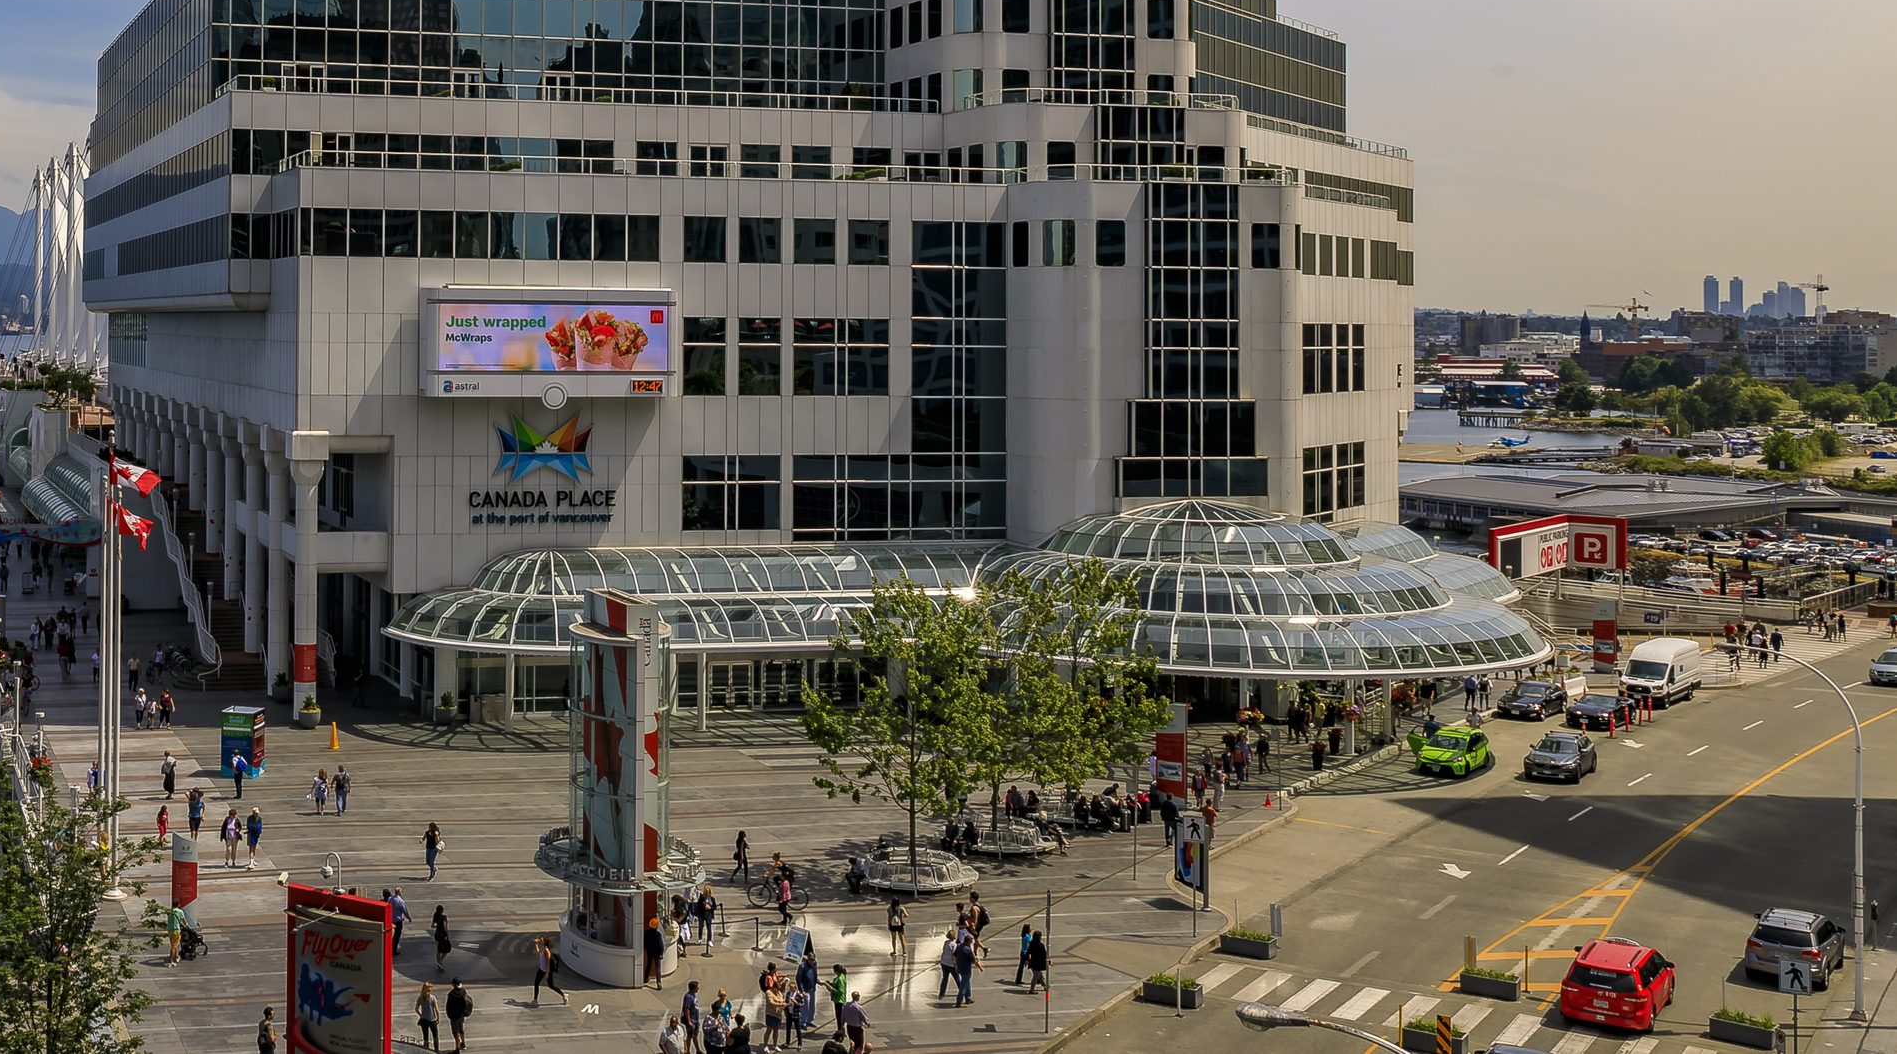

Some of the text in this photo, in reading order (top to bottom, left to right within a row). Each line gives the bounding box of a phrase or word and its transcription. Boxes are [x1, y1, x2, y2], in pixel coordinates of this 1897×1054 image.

[445, 315, 547, 331] Just wrapped
[445, 333, 493, 344] McWraps
[454, 382, 480, 391] astral
[633, 380, 663, 392] 12:47
[468, 490, 617, 508] CANADA PLACE
[471, 511, 614, 527] at the port of vancouver
[1539, 528, 1569, 544] PUBLIC PARKING
[1583, 537, 1602, 559] P
[639, 617, 652, 667] Canada
[301, 930, 374, 966] FlyOver
[330, 961, 362, 972] CANADA
[329, 1033, 348, 1042] VIRTUAL
